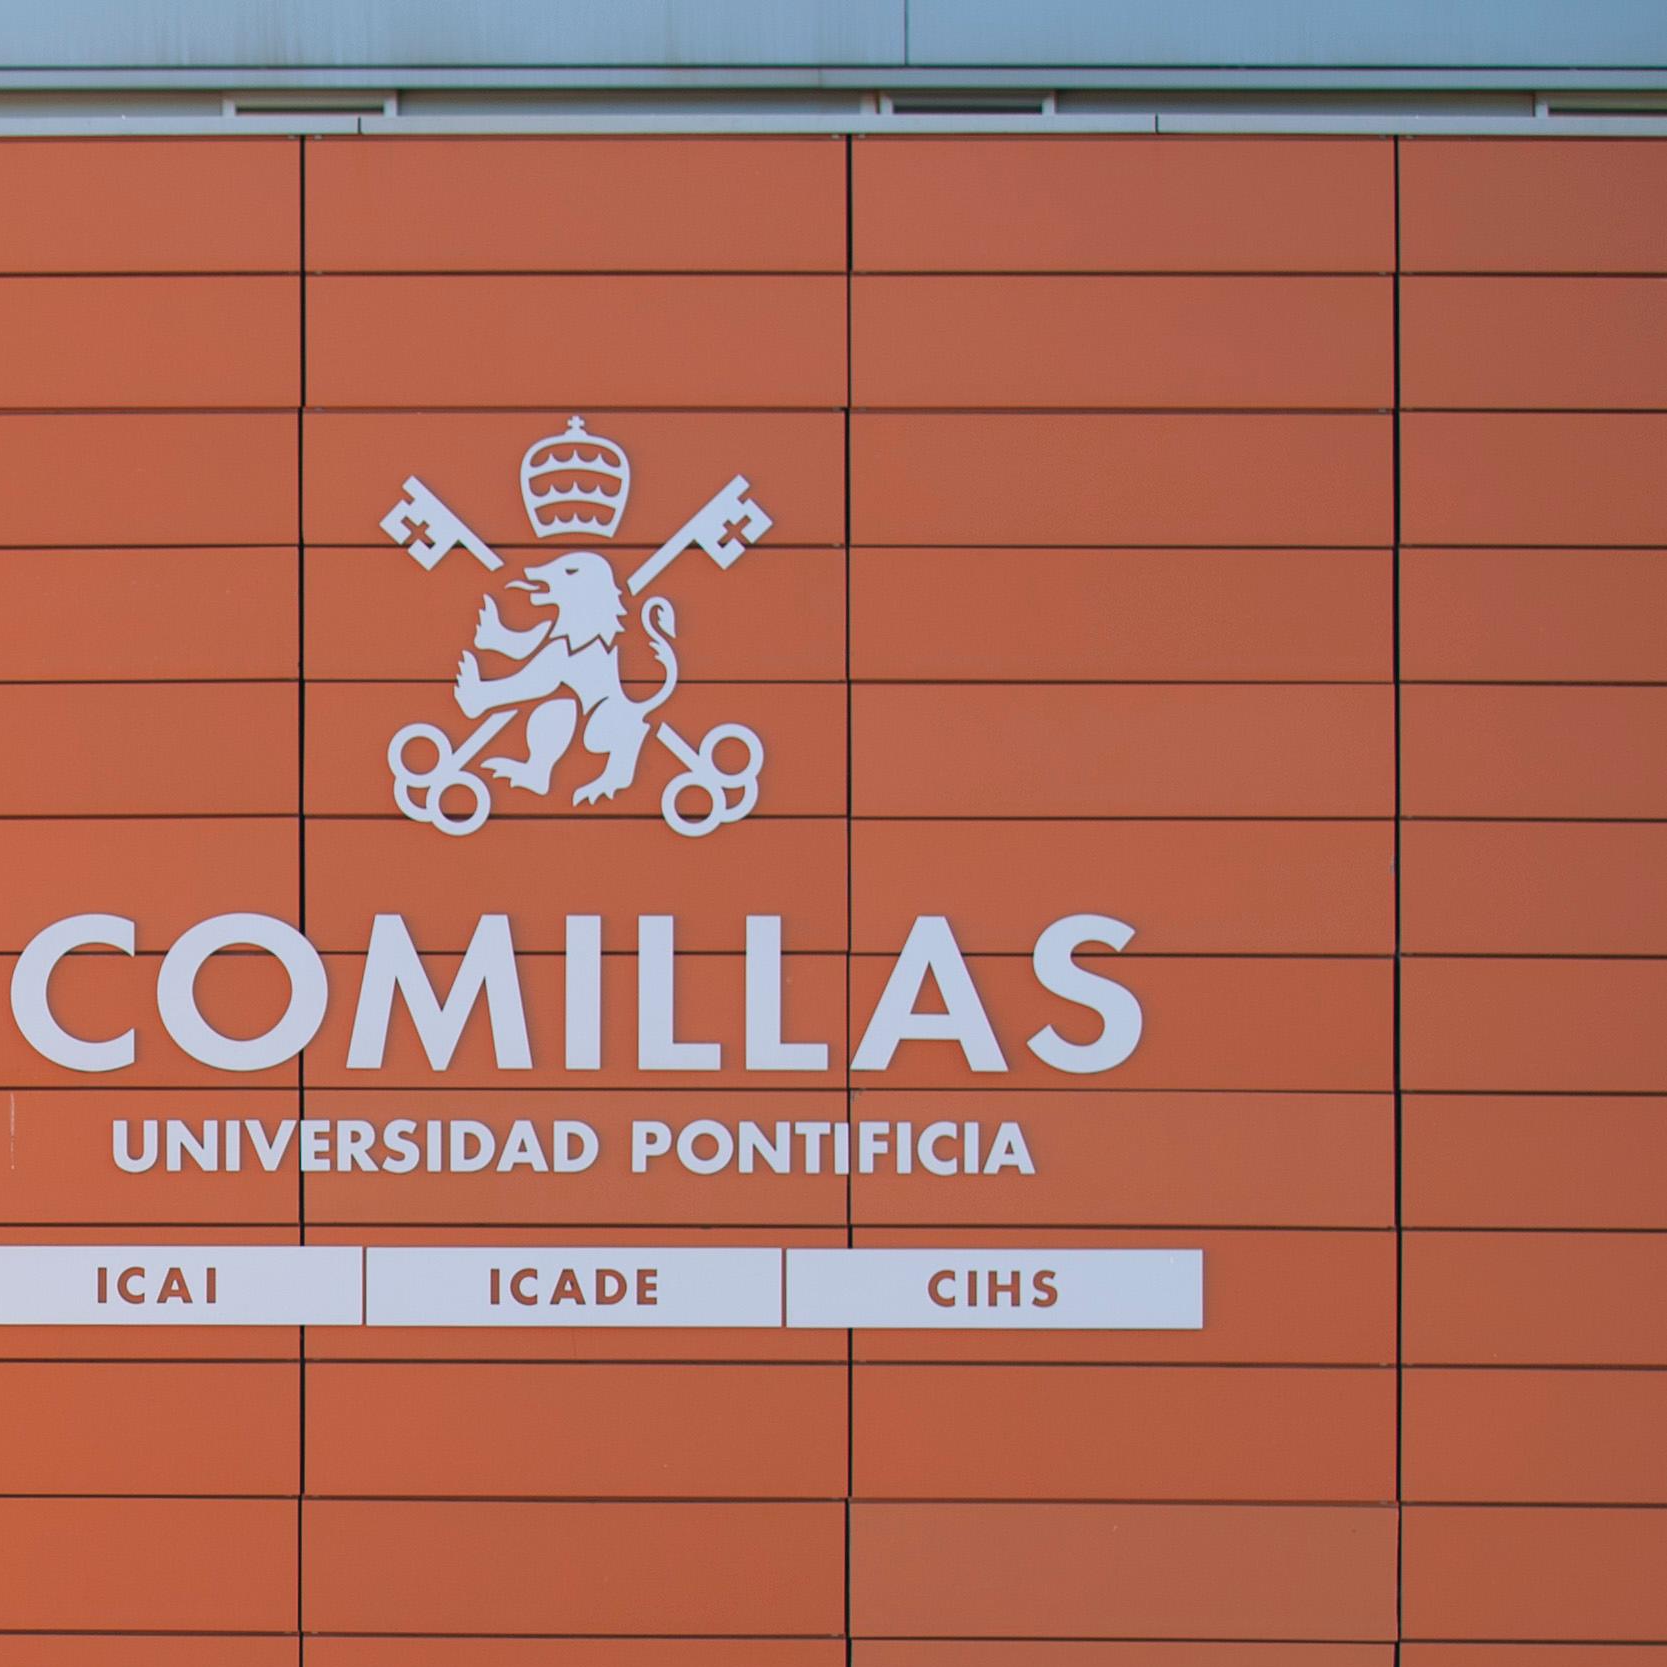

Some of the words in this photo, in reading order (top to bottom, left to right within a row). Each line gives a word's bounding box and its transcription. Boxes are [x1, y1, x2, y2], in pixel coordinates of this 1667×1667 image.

[10, 912, 1143, 1074] COMILLAS
[112, 1118, 599, 1174] UNIVERSIDAD
[631, 1119, 1036, 1176] PONTIFICIA
[97, 1266, 217, 1305] ICAI
[490, 1267, 658, 1306] ICADE
[927, 1269, 1059, 1308] CIHS
